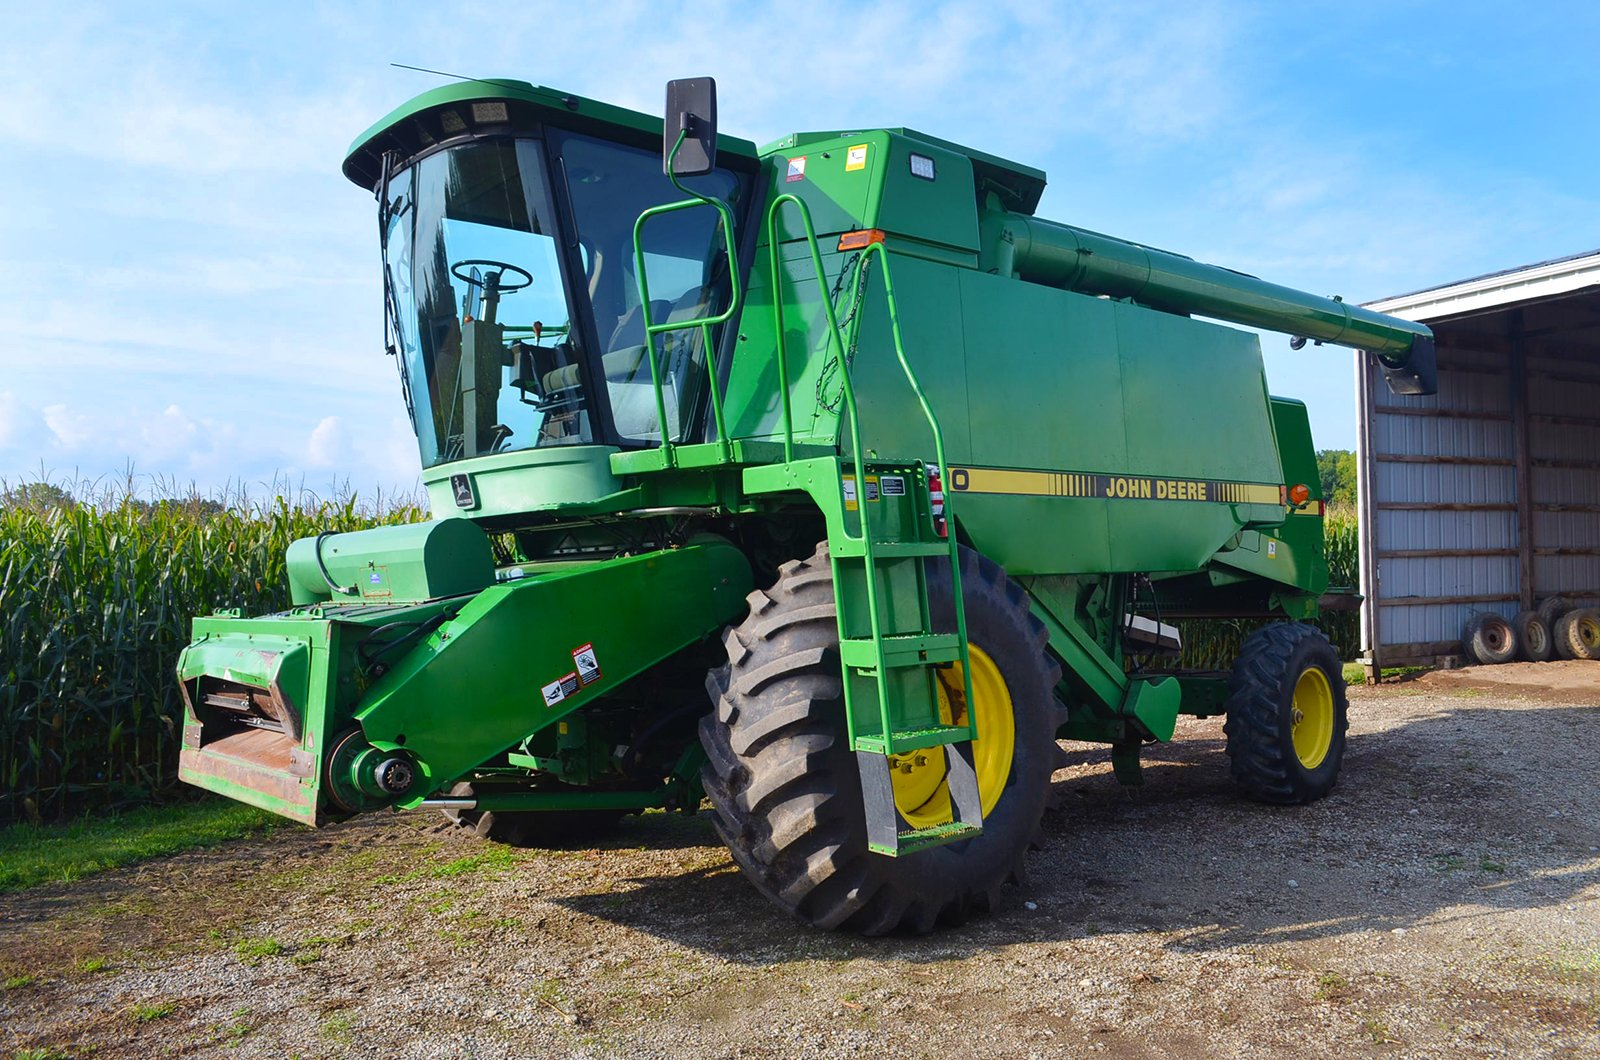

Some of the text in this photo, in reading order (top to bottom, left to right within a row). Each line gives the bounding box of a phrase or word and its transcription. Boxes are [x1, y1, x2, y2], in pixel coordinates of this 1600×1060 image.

[948, 469, 969, 490] 0
[1105, 477, 1207, 500] JOHN DEERE
